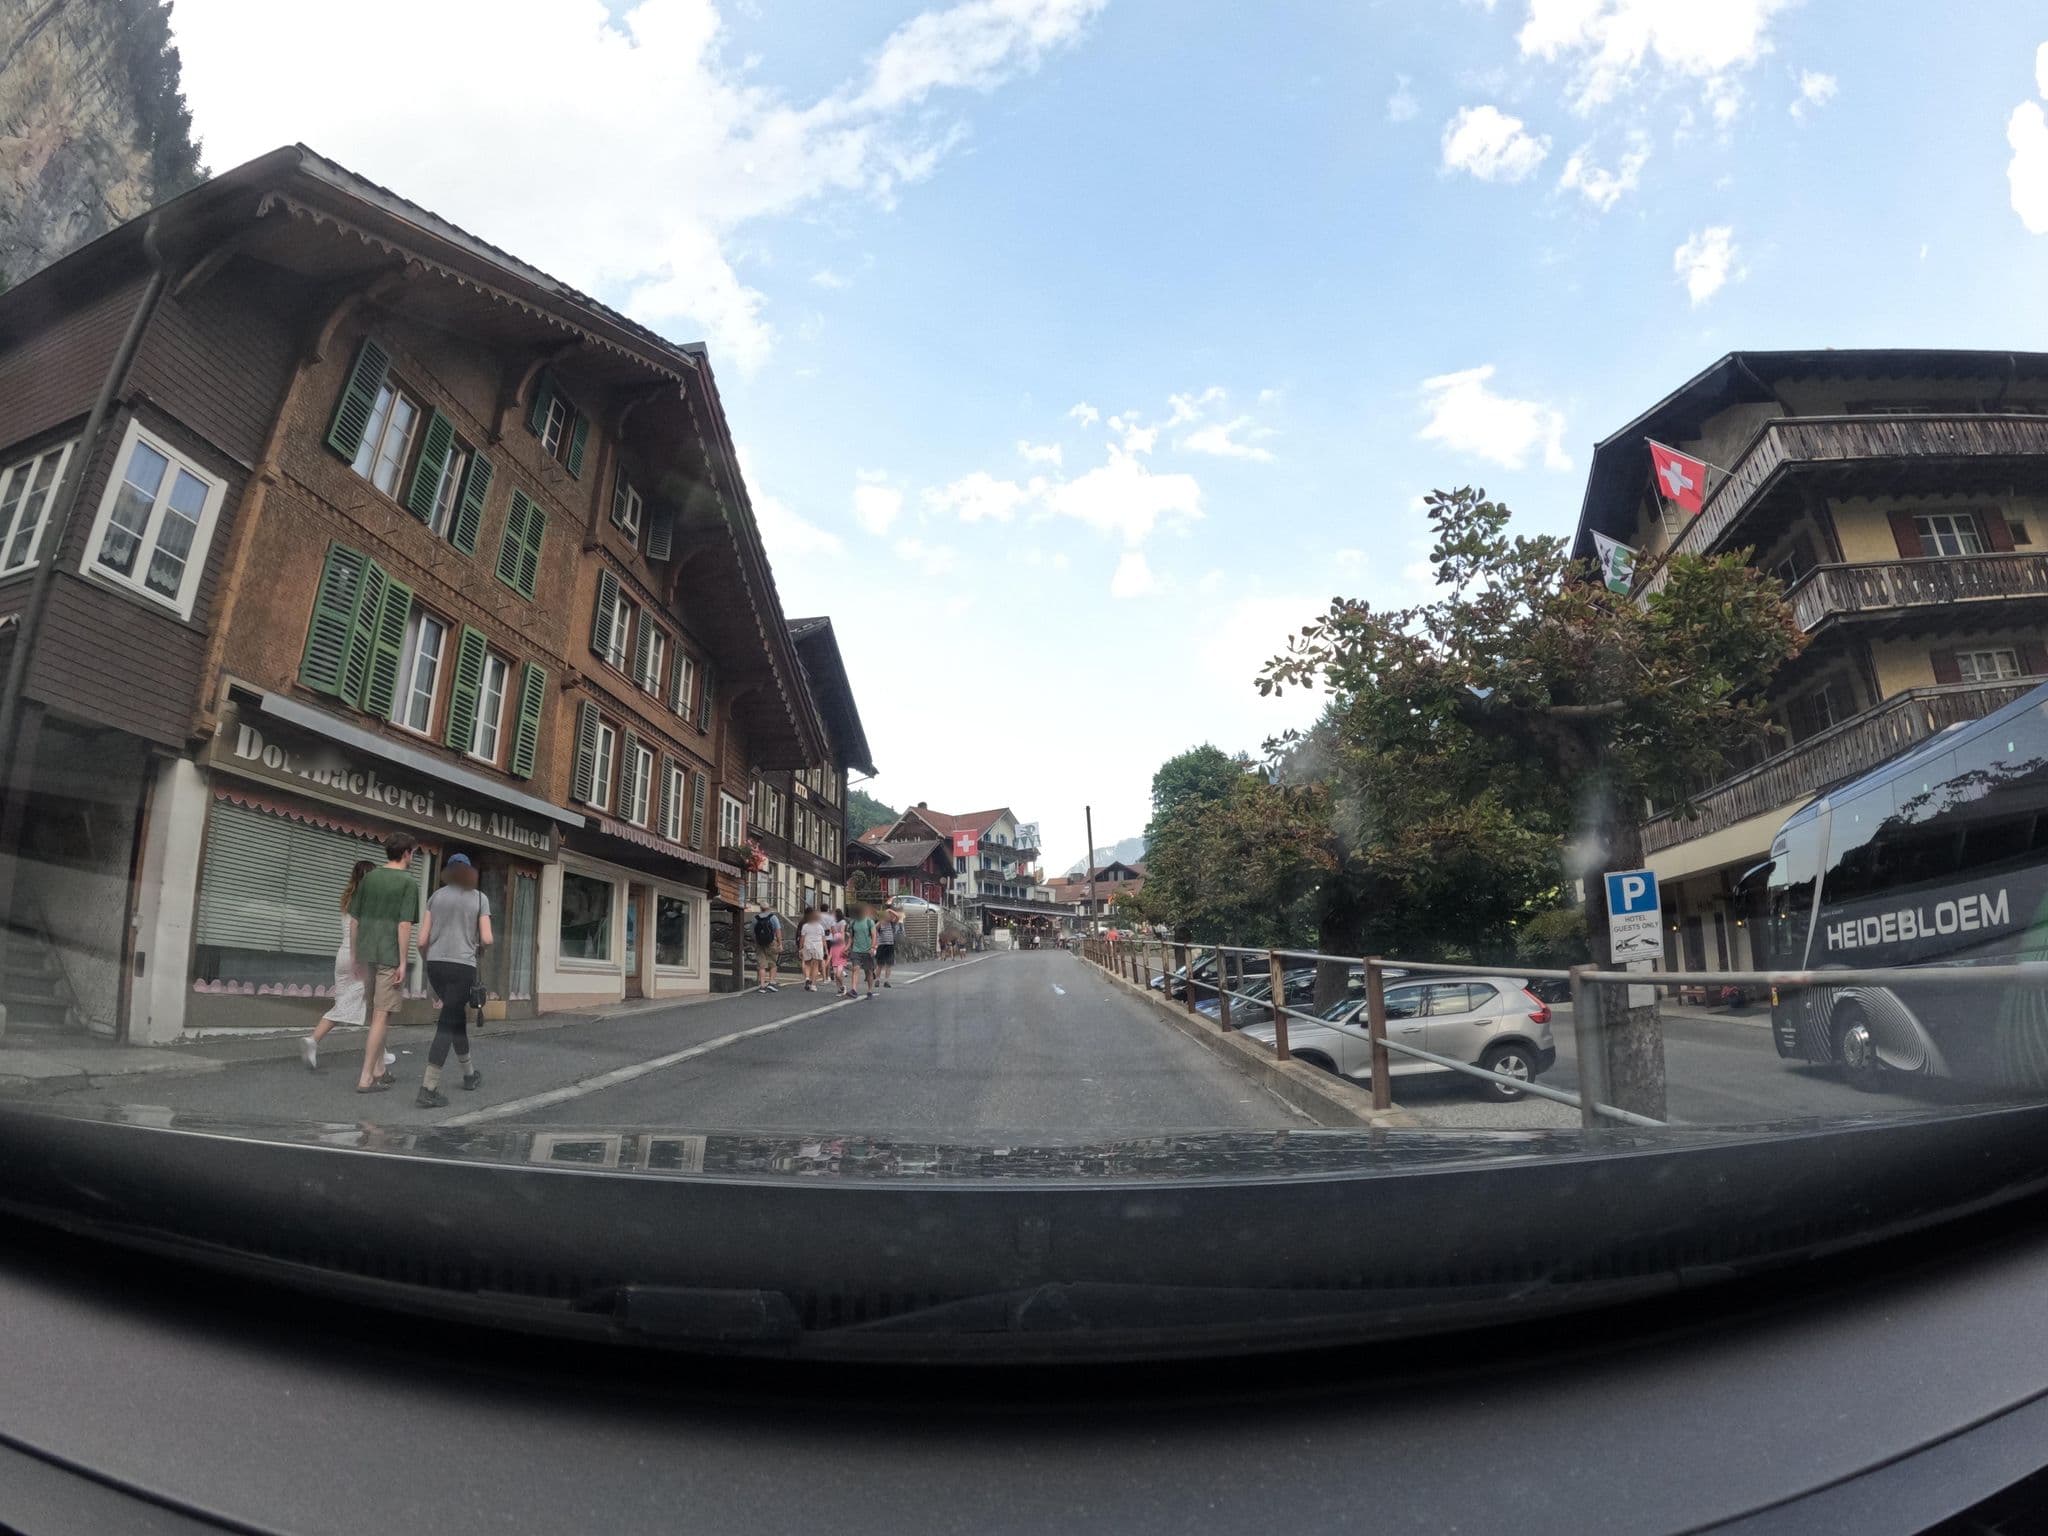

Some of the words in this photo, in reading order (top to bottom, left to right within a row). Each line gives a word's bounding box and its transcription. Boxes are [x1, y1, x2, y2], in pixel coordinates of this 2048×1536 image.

[444, 803, 480, 829] von
[485, 811, 551, 852] Allmen
[1622, 876, 1646, 911] P
[1614, 923, 1641, 933] GUESTS
[1625, 915, 1647, 923] HOTEL
[1828, 889, 2010, 950] HEIDEBLOEM
